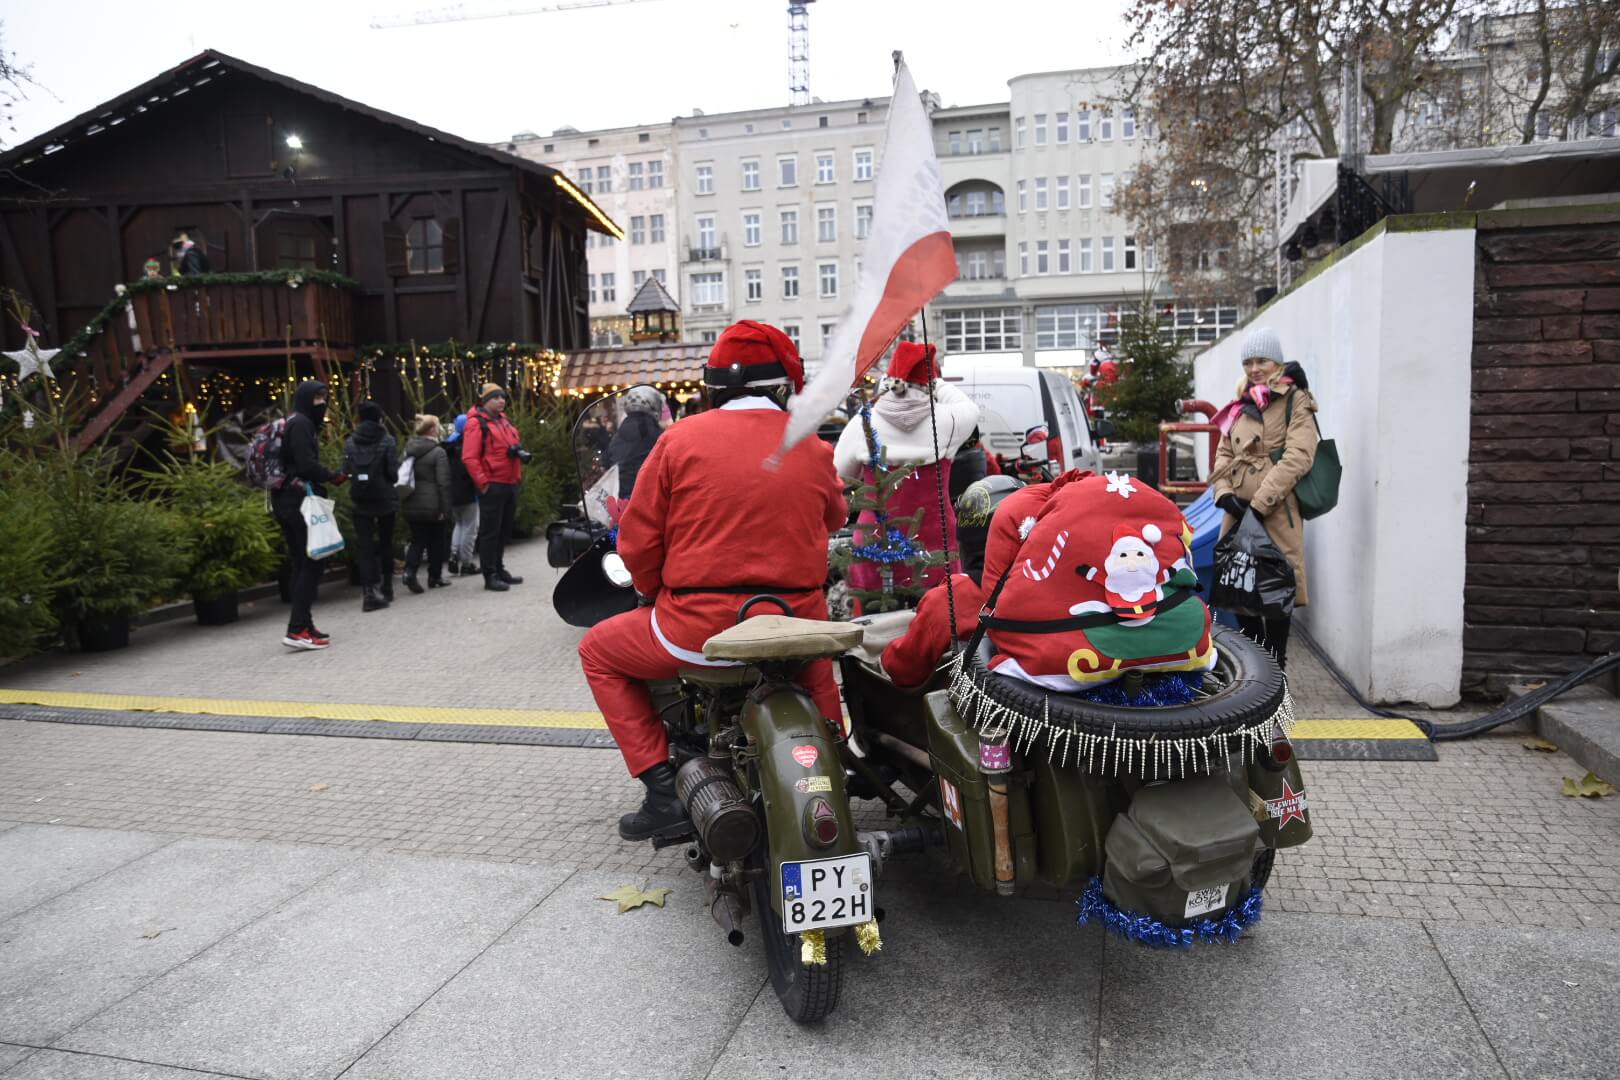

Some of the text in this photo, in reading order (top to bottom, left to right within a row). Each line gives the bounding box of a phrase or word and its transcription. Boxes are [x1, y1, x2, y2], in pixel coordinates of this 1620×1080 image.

[785, 885, 801, 896] PL
[811, 866, 845, 891] PY
[791, 894, 865, 924] 822H
